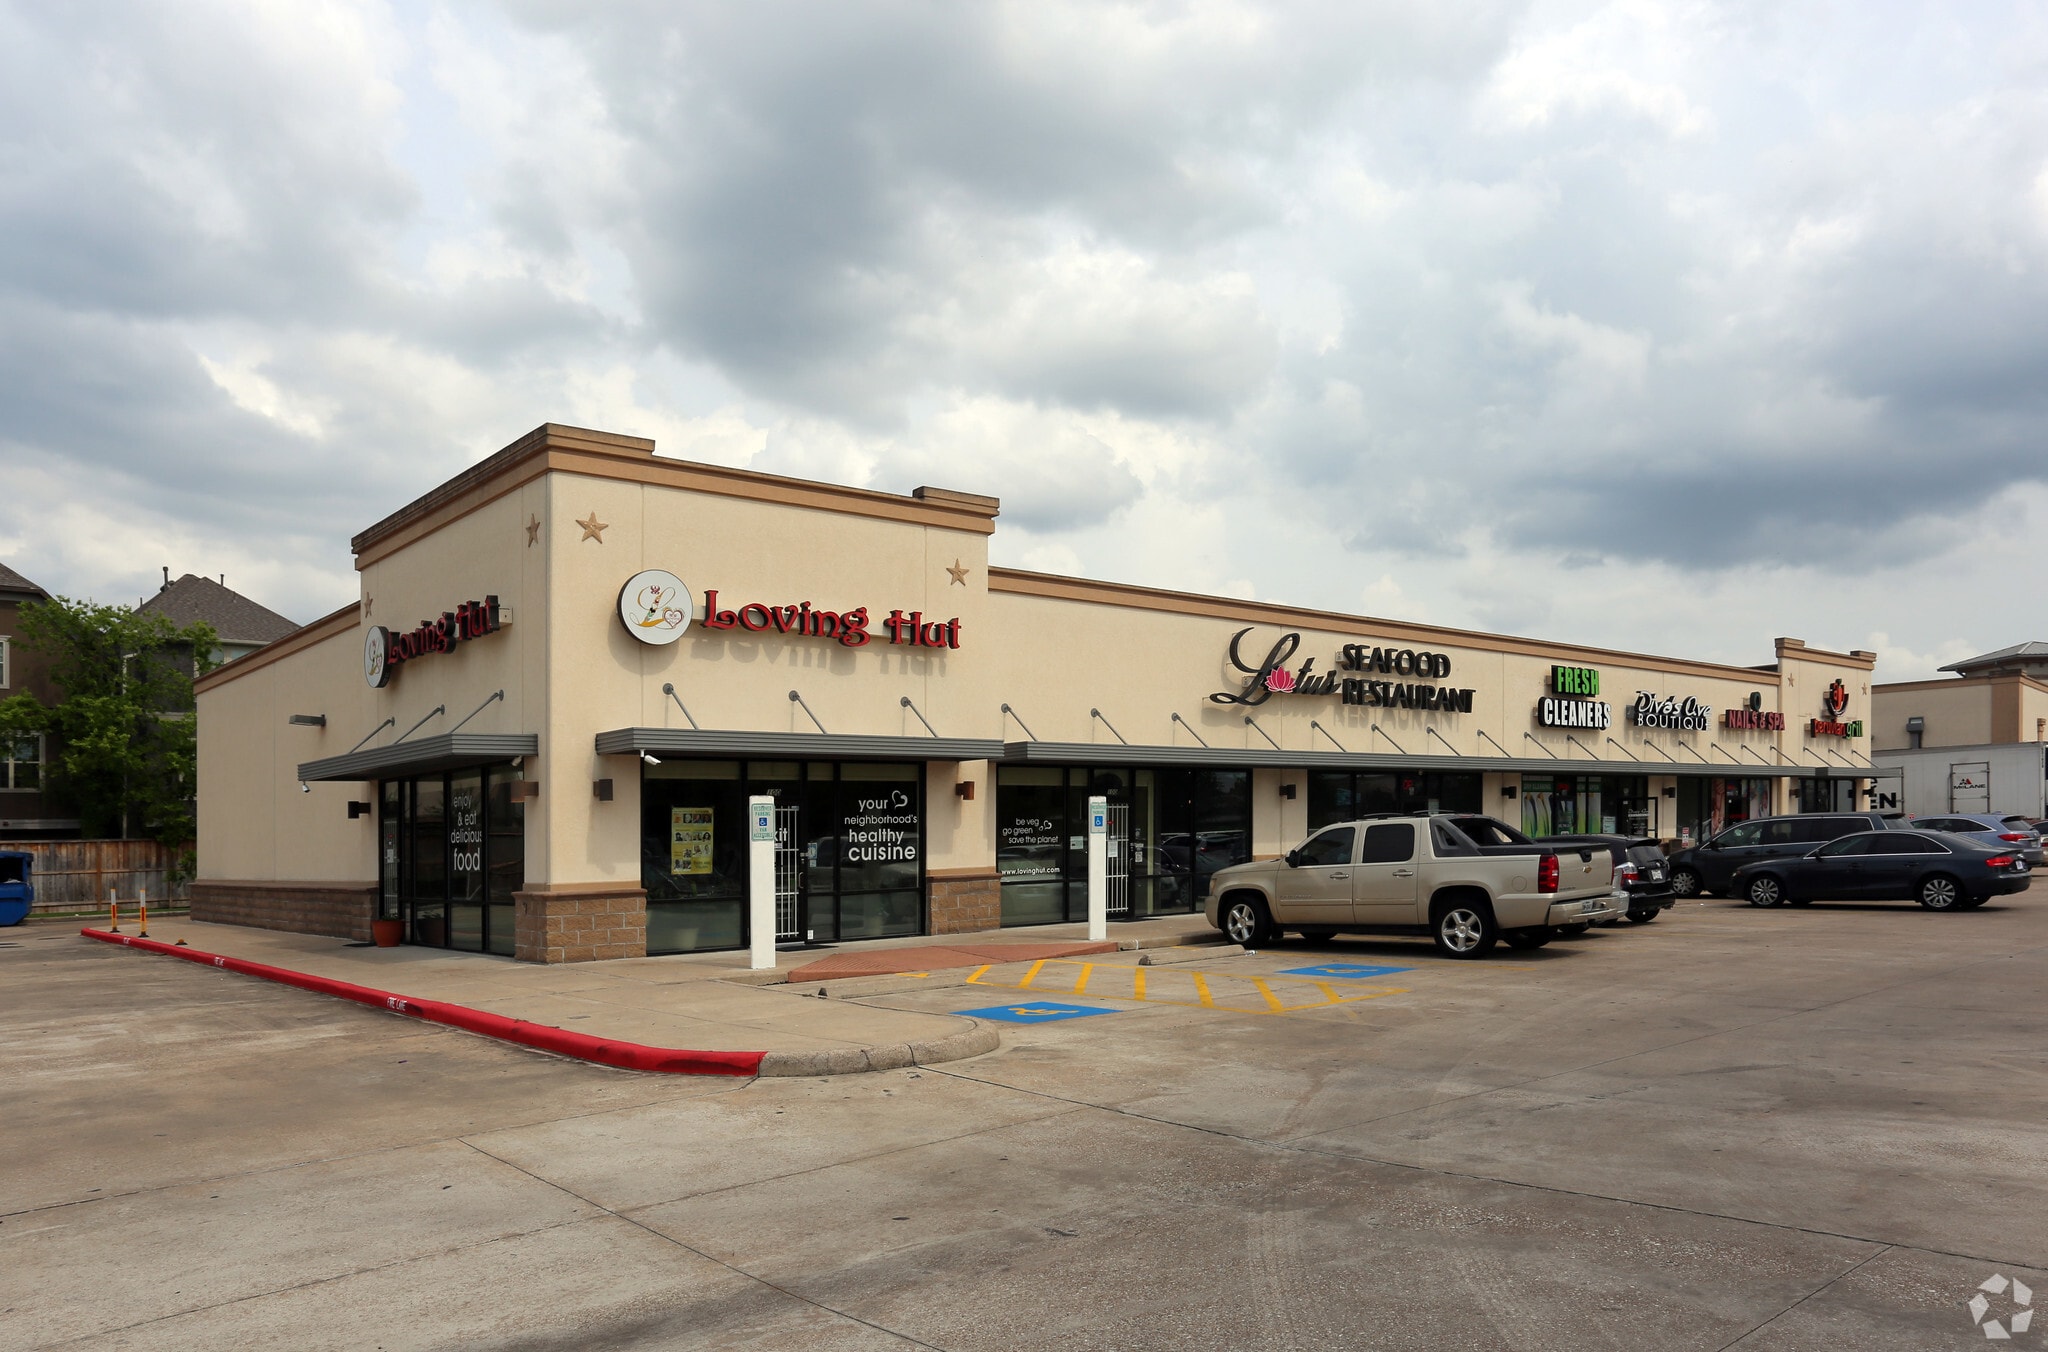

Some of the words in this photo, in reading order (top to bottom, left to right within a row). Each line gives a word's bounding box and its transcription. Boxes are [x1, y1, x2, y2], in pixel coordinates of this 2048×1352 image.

[700, 590, 871, 647] Loving
[884, 610, 962, 649] Hut
[387, 612, 456, 664] Loving
[456, 595, 500, 640] Hut
[1209, 626, 1343, 706] Ltus
[1342, 643, 1451, 678] SEAFOOD
[1551, 665, 1600, 697] FRESH
[1342, 678, 1476, 713] RESTAURANT
[1538, 697, 1611, 731] CLEANERS
[1726, 710, 1757, 729] NAILS
[1759, 711, 1766, 729] &
[1766, 712, 1785, 731] SPA
[1846, 720, 1863, 740] grill
[453, 793, 472, 809] enjoy
[858, 798, 888, 813] your
[457, 811, 463, 826] &
[464, 810, 477, 826] eat
[844, 814, 918, 827] neighborhood's
[1027, 819, 1039, 827] veg
[848, 828, 904, 844] healthy
[1002, 828, 1012, 836] go
[1013, 828, 1033, 836] green
[1025, 836, 1036, 844] the
[1037, 835, 1059, 845] planet
[453, 847, 480, 871] food
[848, 843, 916, 861] cuisine
[1001, 867, 1060, 876] www.lovinghut.com
